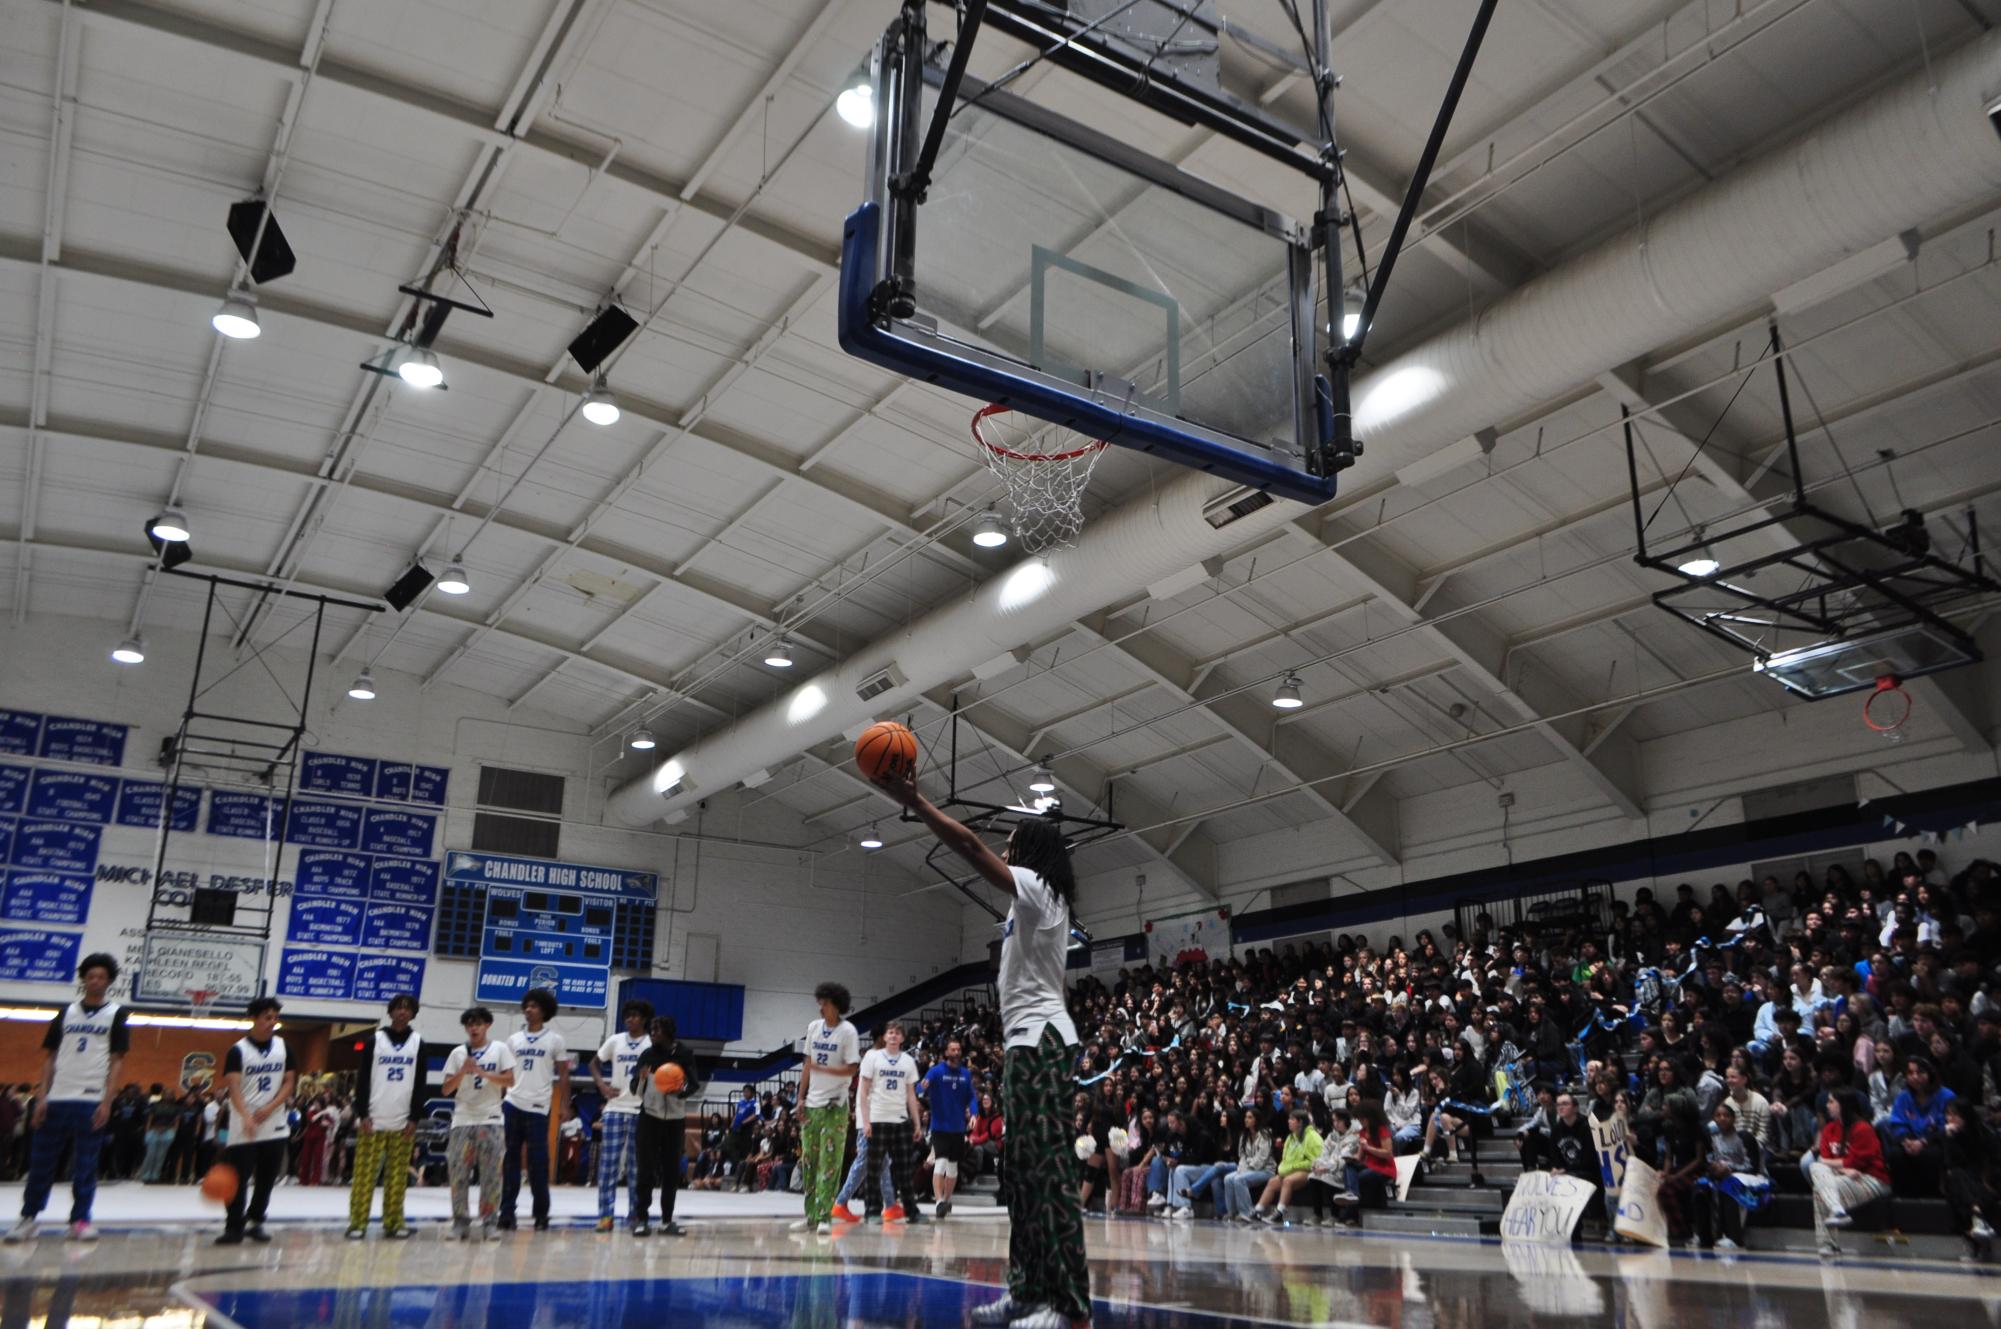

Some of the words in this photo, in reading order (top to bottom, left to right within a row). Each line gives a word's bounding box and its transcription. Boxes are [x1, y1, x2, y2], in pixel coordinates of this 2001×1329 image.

[307, 757, 346, 766] CHANDLER
[350, 760, 369, 772] HIGH
[423, 769, 441, 782] HIGH
[39, 775, 86, 785] CHANDLER
[89, 779, 111, 792] HIGH
[214, 795, 260, 805] CHANDLER
[36, 806, 59, 816] STATE
[64, 810, 102, 820] CHAMPIONS
[293, 805, 336, 814] CHANDLER
[339, 809, 359, 820] HIGH
[370, 813, 408, 823] CHANDLER
[411, 817, 429, 829] HIGH
[23, 824, 70, 833] CHANDLER
[73, 827, 96, 840] HIGH
[307, 826, 339, 836] BASEBALL
[294, 834, 313, 843] STATE
[315, 836, 351, 846] RUNNER-UP
[382, 835, 412, 845] BASEBALL
[369, 842, 387, 851] STATE
[392, 845, 424, 855] CHAMPIONS
[21, 856, 43, 864] STATE
[48, 858, 87, 869] CHAMPIONS
[304, 853, 343, 863] CHANDLER
[346, 856, 367, 868] HIGH
[374, 860, 412, 869] CHANDLER
[414, 864, 433, 875] HIGH
[313, 875, 329, 883] BOYS
[334, 877, 353, 886] TRACK
[380, 872, 391, 880] AAA
[484, 861, 545, 883] CHANDLER
[549, 867, 576, 887] HIGH
[579, 870, 623, 892] SCHOOL
[13, 874, 60, 885] CHANDLER
[63, 879, 87, 892] HIGH
[385, 881, 415, 891] BASEBALL
[18, 888, 33, 897] AAA
[304, 884, 322, 892] STATE
[327, 886, 360, 896] CHAMPIONS
[491, 888, 521, 898] WOLVES
[395, 892, 427, 902] RUNNER-UP
[584, 897, 614, 908] VISITOR
[10, 898, 31, 907] BOYS
[36, 900, 79, 911] BASKETBALL
[297, 900, 336, 910] CHANDLER
[340, 903, 359, 915] HIGH
[9, 908, 32, 918] STATE
[38, 910, 78, 921] CHAMPIONS
[302, 912, 314, 921] AAA
[368, 906, 406, 917] CHANDLER
[409, 908, 428, 921] HIGH
[309, 923, 343, 933] BADMINTON
[373, 919, 384, 927] AAA
[498, 919, 519, 928] BONUS
[534, 919, 556, 927] PERIOD
[379, 928, 411, 938] BADMINTON
[580, 927, 600, 935] BONUS
[50, 935, 74, 949] HIGH
[296, 931, 315, 940] STATE
[320, 934, 353, 943] CHAMPIONS
[584, 937, 602, 945] FOULS
[368, 937, 385, 945] STATE
[389, 939, 421, 949] CHAMPIONS
[534, 940, 563, 948] TIMEOUTS
[5, 946, 20, 955] AAA
[540, 947, 555, 955] LEFT
[34, 959, 57, 967] TRACK
[287, 953, 328, 964] CHANDLER
[331, 956, 351, 968] HIGH
[359, 957, 397, 968] CHANDLER
[400, 961, 419, 973] HIGH
[25, 969, 66, 979] RUNNER-UP
[292, 966, 304, 974] AAA
[363, 971, 375, 979] AAA
[308, 978, 345, 987] BASKETBALL
[357, 980, 375, 988] GIRLS
[379, 982, 414, 991] BASKETBALL
[481, 973, 515, 987] DONATED
[517, 976, 529, 987] BY
[285, 985, 304, 993] STATE
[310, 987, 344, 996] RUNNER-UP
[357, 989, 375, 998] STATE
[63, 1024, 108, 1036] CHANDLER
[77, 1037, 86, 1053] 3
[812, 1041, 838, 1052] CHANDLER
[515, 1048, 545, 1058] CHANDLER
[378, 1055, 414, 1066] CHANDLER
[522, 1059, 534, 1071] 21
[816, 1053, 828, 1066] 22
[245, 1062, 283, 1075] CHANDLER
[387, 1067, 405, 1081] 25
[879, 1069, 905, 1079] CHANDLER
[258, 1076, 272, 1091] 12
[474, 1076, 482, 1090] 2
[886, 1079, 898, 1090] 20
[1505, 1206, 1537, 1237] HEAR
[1539, 1206, 1574, 1238] YOU
